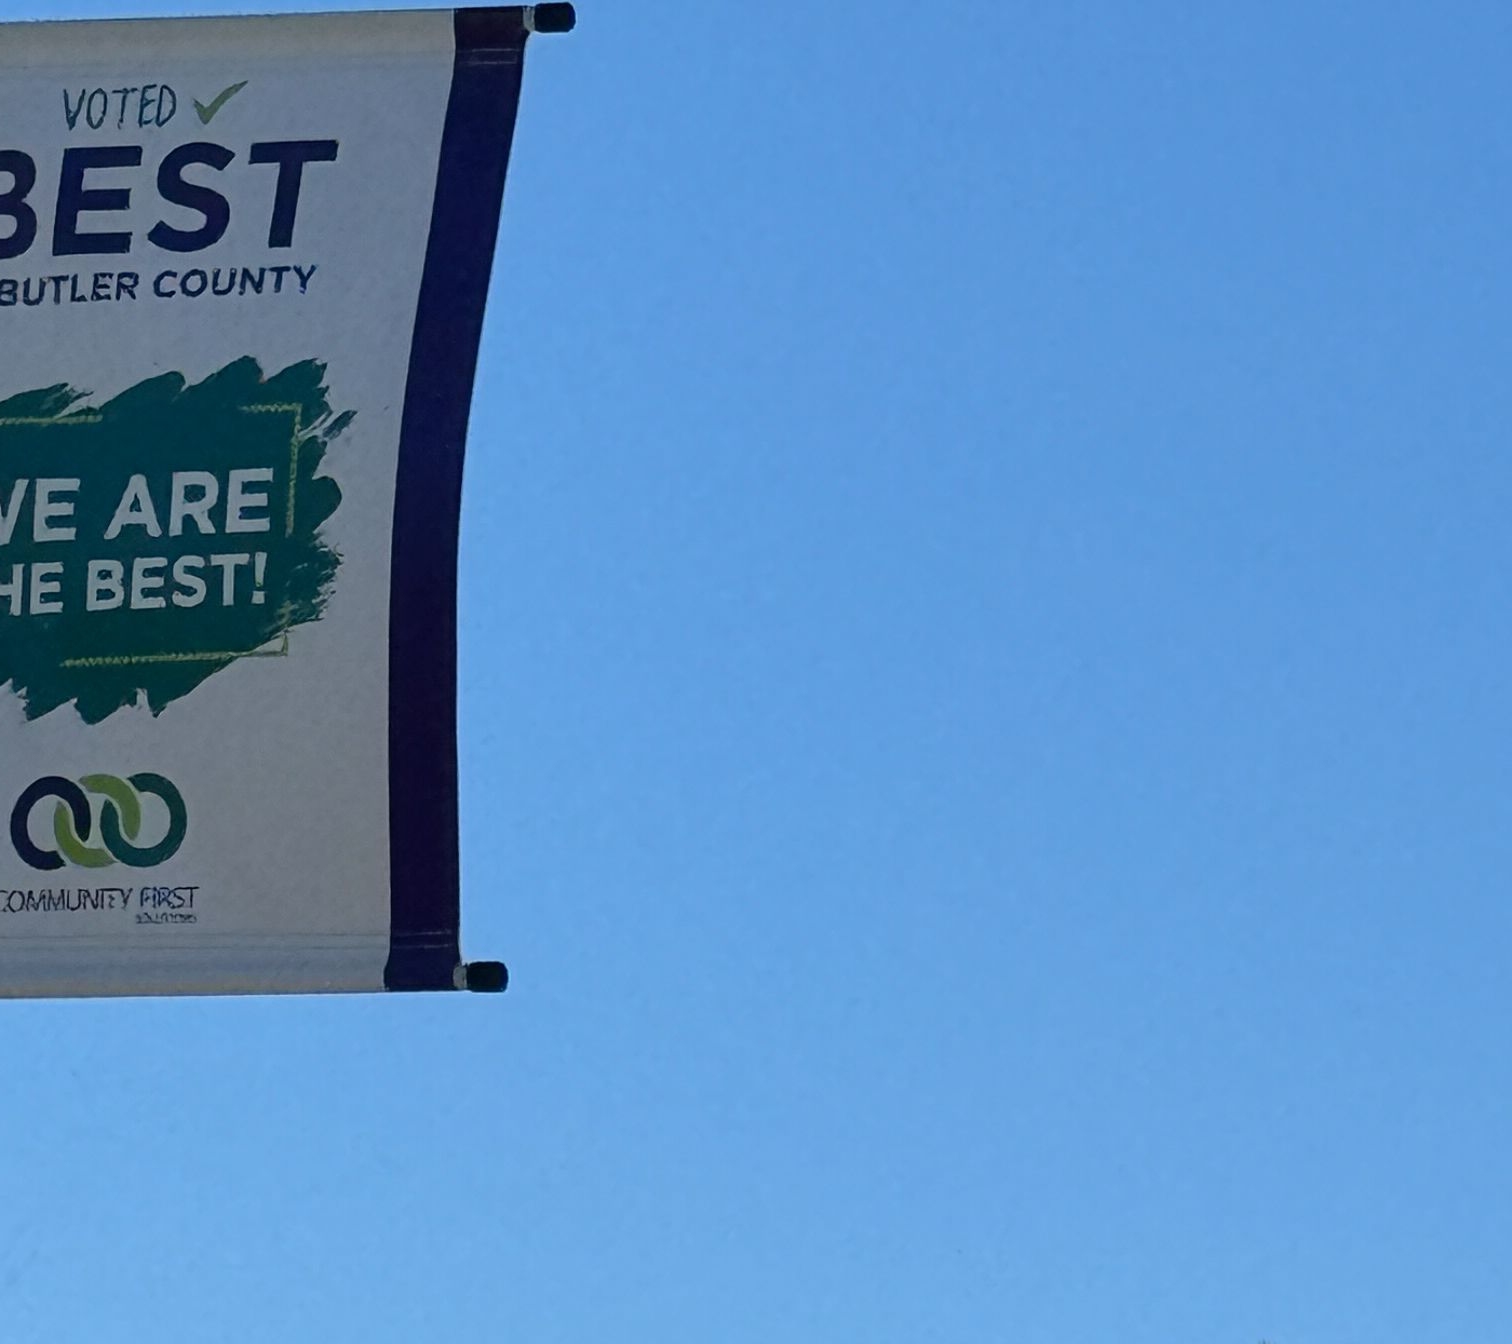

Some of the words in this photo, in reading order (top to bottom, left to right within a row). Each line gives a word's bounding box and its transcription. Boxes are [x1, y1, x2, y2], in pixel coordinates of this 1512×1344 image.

[64, 84, 176, 130] VOTED
[152, 264, 318, 299] COUNTY
[104, 468, 274, 539] ARE
[86, 552, 268, 612] BEST!
[139, 886, 200, 909] FIRST
